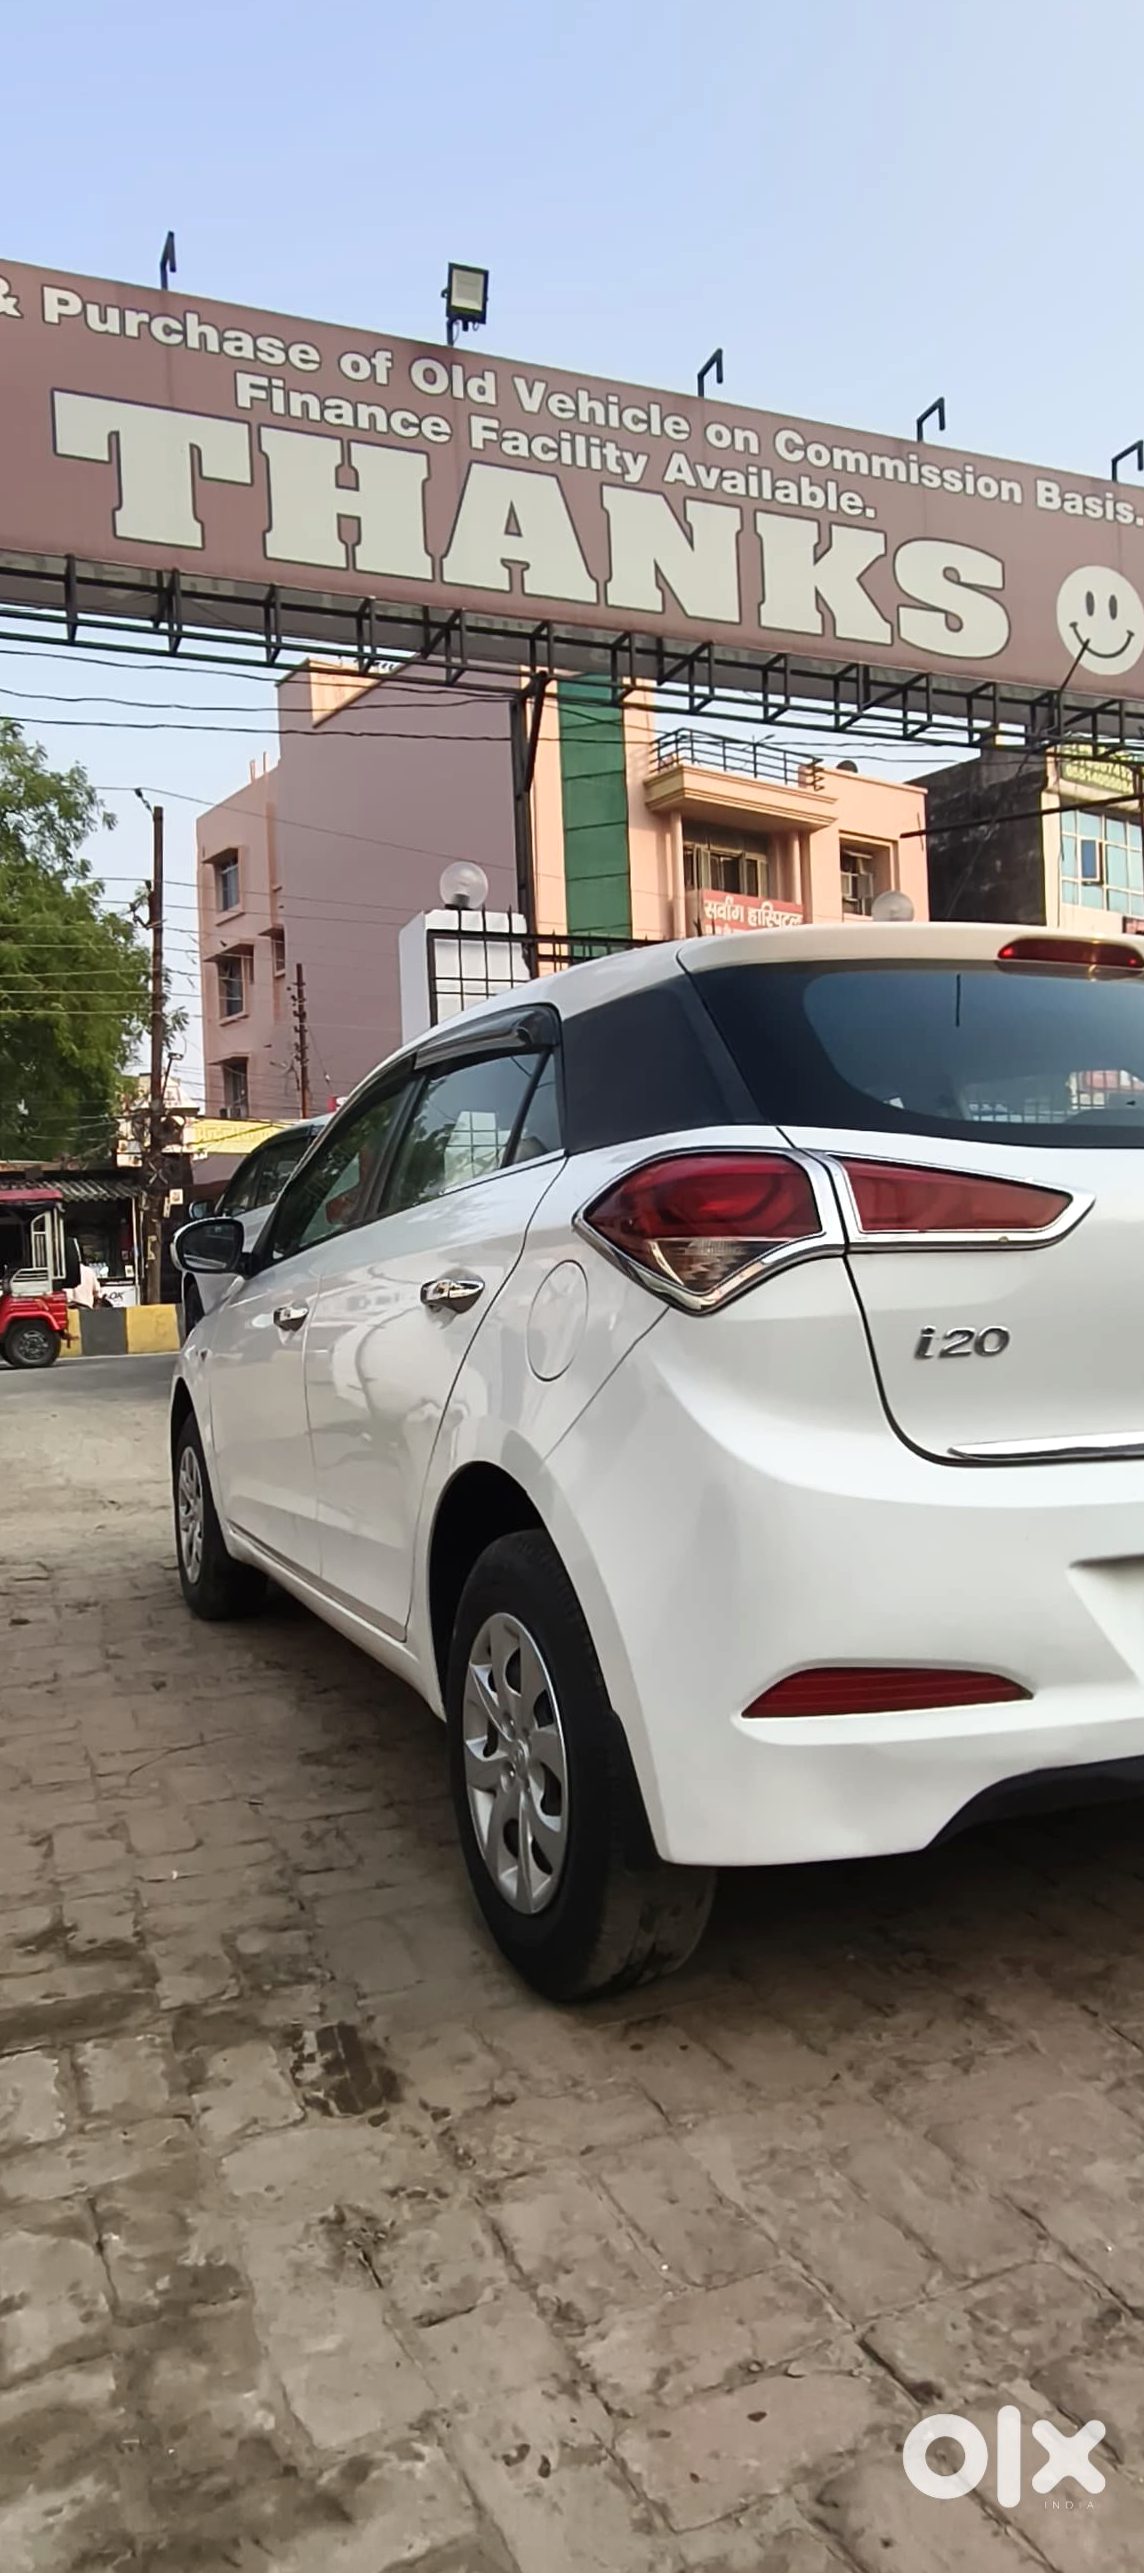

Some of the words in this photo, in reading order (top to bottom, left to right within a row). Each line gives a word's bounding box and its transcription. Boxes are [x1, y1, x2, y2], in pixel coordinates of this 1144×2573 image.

[42, 286, 320, 371] Purchase
[339, 350, 393, 385] of
[410, 361, 497, 406] Old
[513, 376, 691, 441] Vehicle
[705, 423, 760, 455] on
[774, 429, 1023, 505] Commission
[1035, 479, 1144, 527] Basis.
[235, 371, 452, 443] Finance
[469, 414, 648, 483] Facility
[663, 452, 876, 519] Available.
[52, 389, 1011, 660] THANKS
[914, 1325, 1010, 1360] i20
